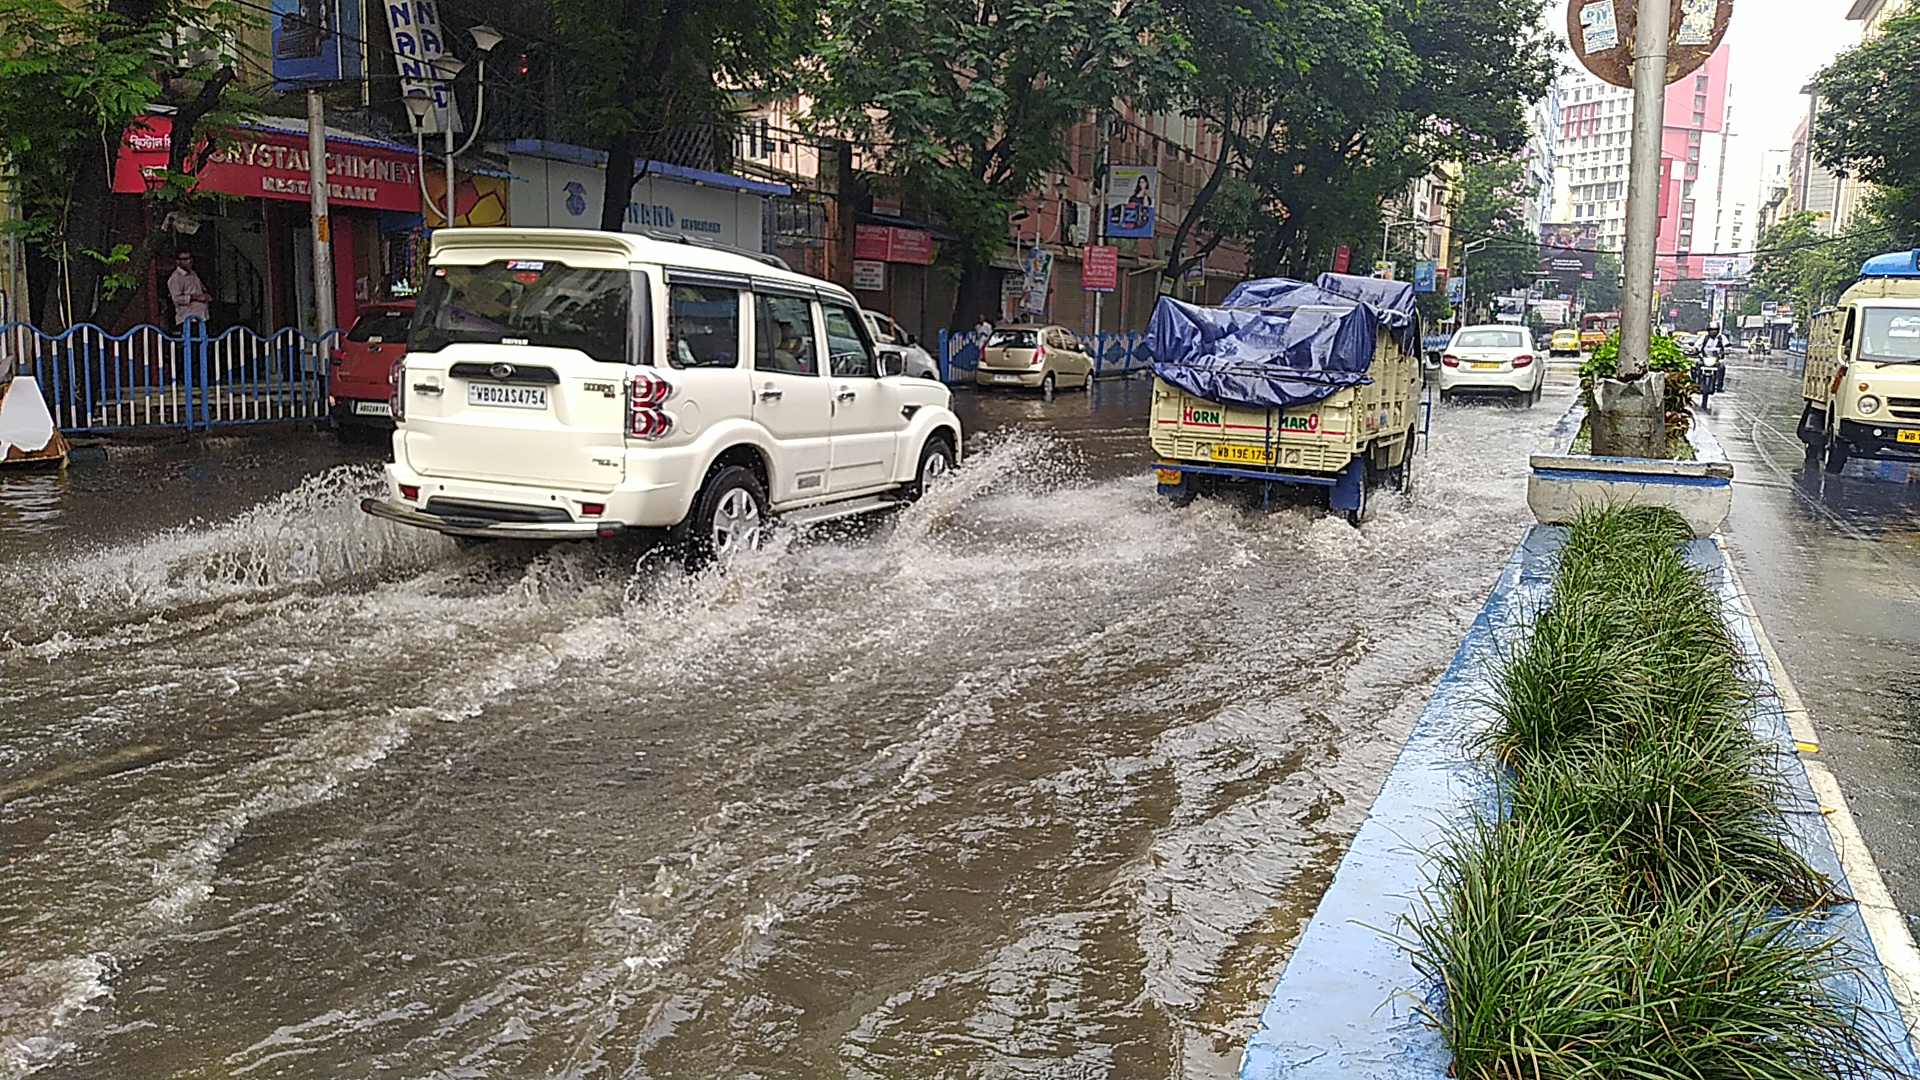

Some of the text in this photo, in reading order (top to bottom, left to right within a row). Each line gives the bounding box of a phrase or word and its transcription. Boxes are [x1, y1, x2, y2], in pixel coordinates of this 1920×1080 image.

[324, 152, 417, 184] CHIMNEY
[262, 176, 377, 202] RESTRANT
[476, 386, 546, 405] WB02AS4754
[1182, 405, 1220, 425] HORN
[1904, 432, 1916, 441] WB
[1217, 446, 1229, 458] WB
[1232, 448, 1248, 459] 19E
